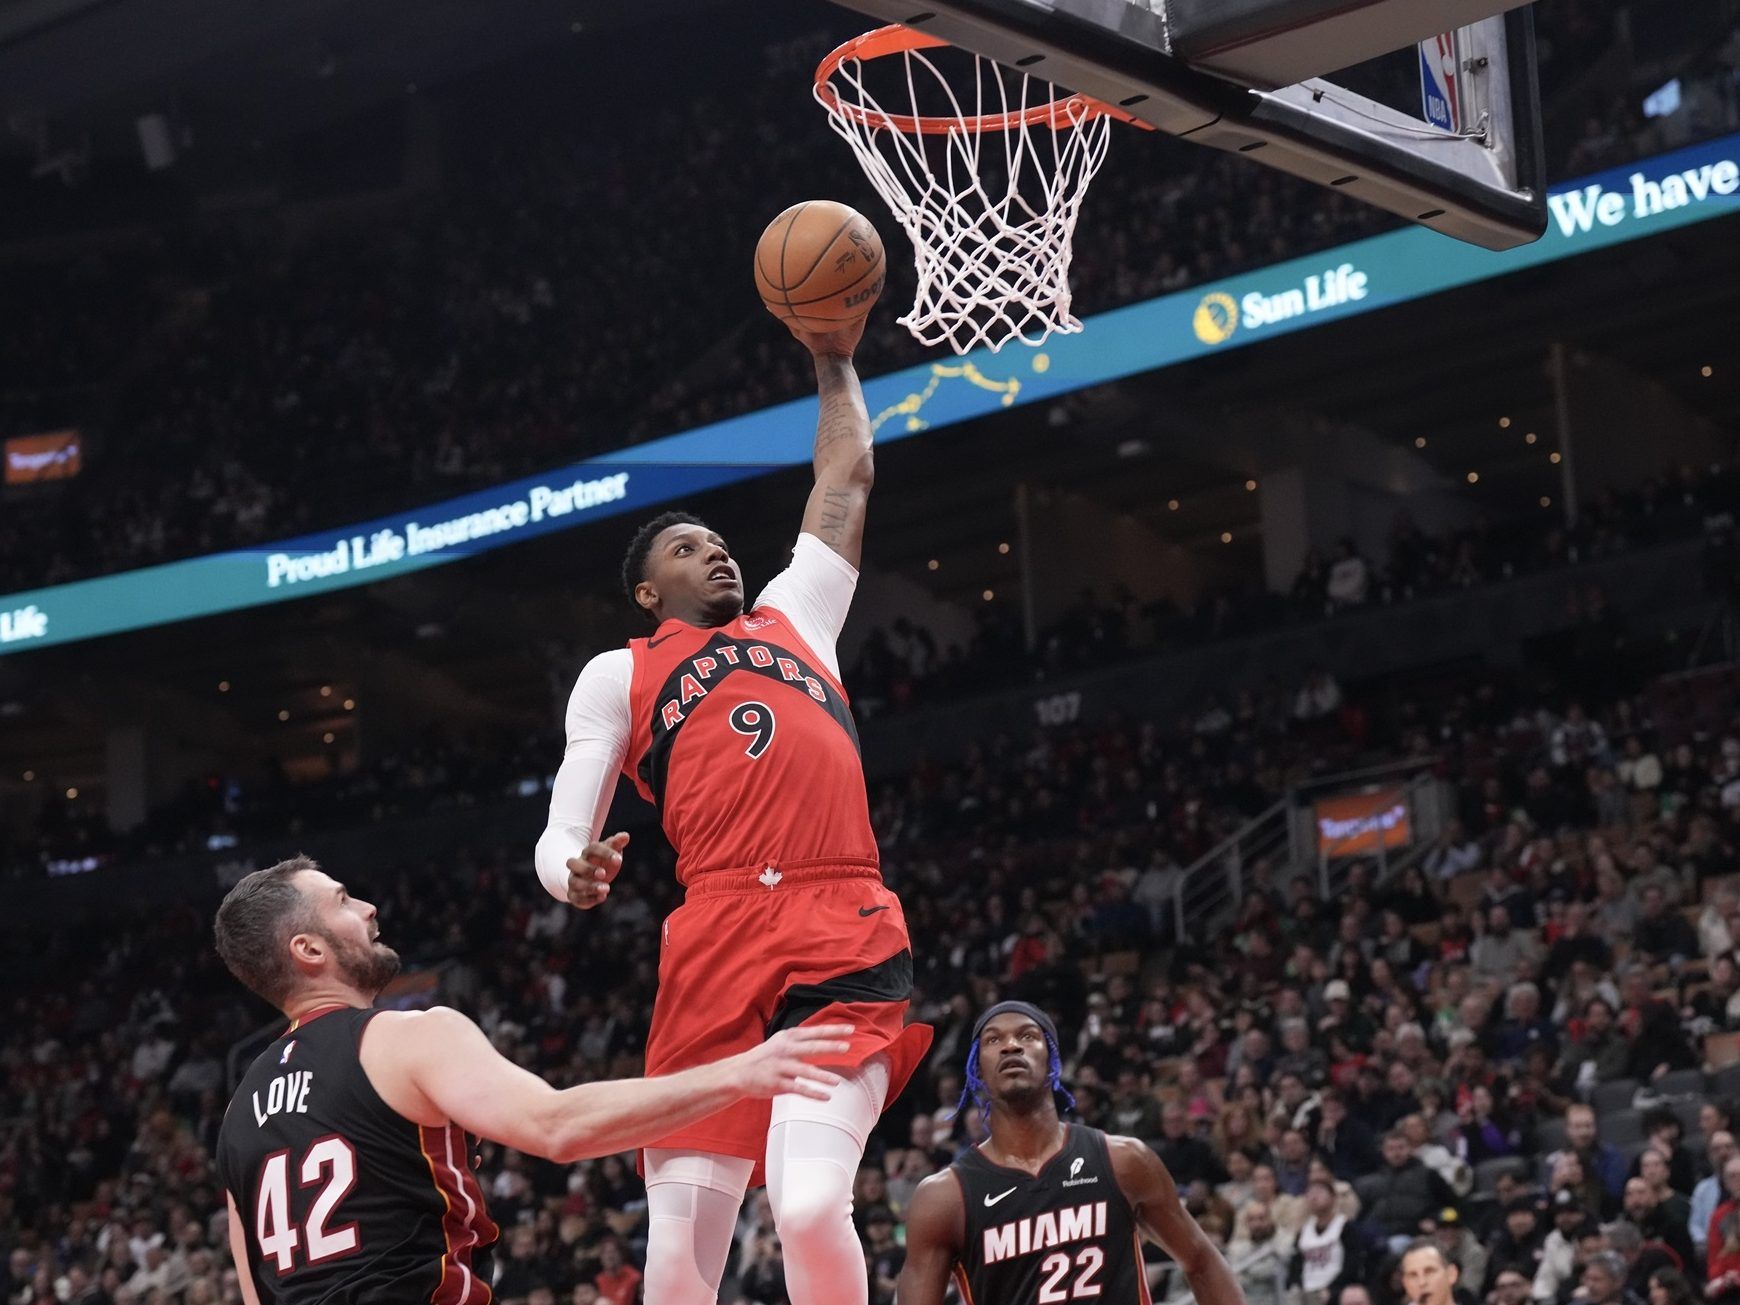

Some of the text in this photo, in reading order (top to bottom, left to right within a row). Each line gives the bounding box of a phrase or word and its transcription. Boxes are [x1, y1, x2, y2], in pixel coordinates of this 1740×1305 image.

[1428, 95, 1448, 123] NBA
[1547, 160, 1740, 237] We have
[1242, 263, 1368, 329] Sun Life
[266, 472, 629, 587] Proud Life Insurance Partner
[0, 605, 48, 642] Life
[661, 645, 826, 731] RAPTORS
[729, 701, 776, 760] 9
[253, 1070, 313, 1128] LOVE
[257, 1134, 360, 1274] 42
[983, 1201, 1107, 1265] MIAMI
[1038, 1246, 1104, 1304] 22
